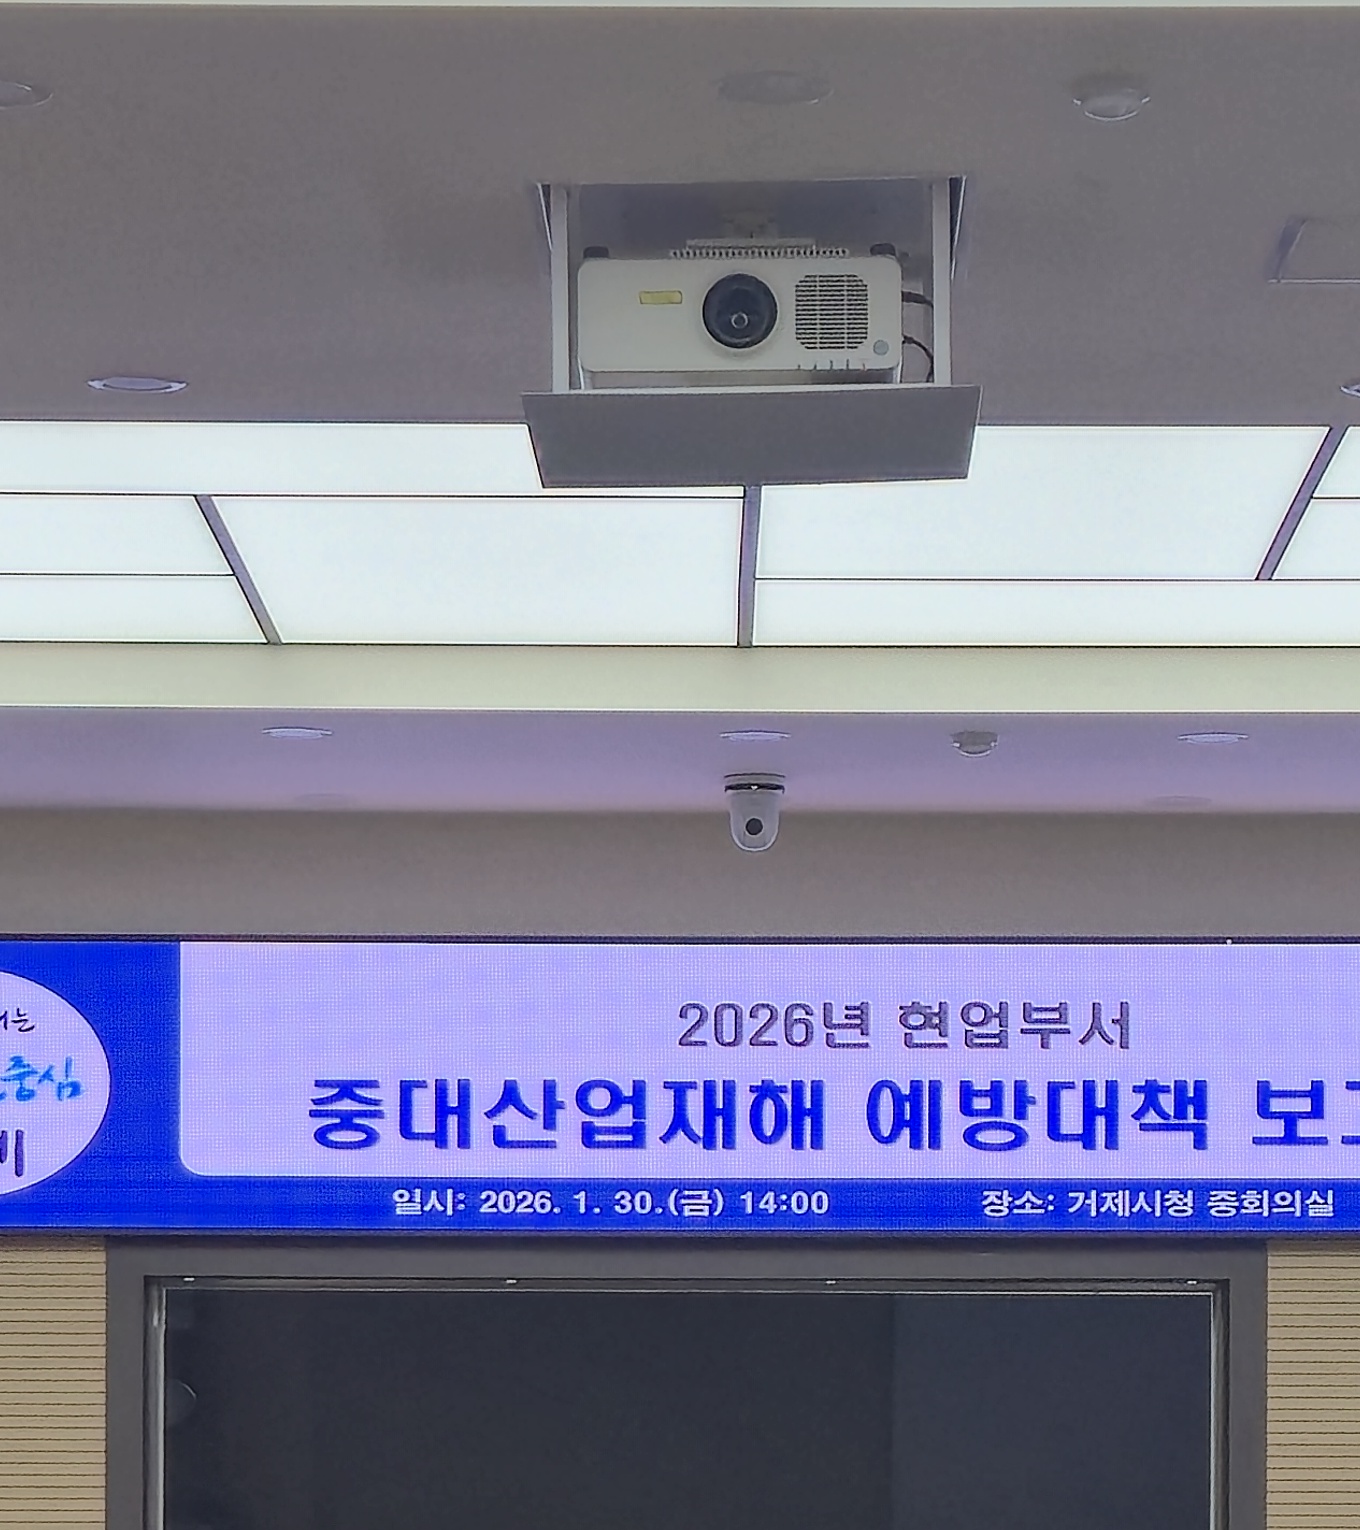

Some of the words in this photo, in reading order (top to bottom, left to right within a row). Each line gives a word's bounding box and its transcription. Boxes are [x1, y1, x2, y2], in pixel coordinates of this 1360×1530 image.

[678, 1002, 871, 1051] 2026년
[898, 1002, 1131, 1051] 현업부서
[308, 1079, 826, 1153] 중대산업재해
[866, 1079, 1210, 1153] 예방대책
[392, 1189, 467, 1217] 일시:
[479, 1190, 562, 1215] 2026.
[574, 1190, 602, 1215] 1.
[613, 1189, 725, 1217] 30.(금)
[740, 1191, 830, 1215] 14:00
[982, 1190, 1056, 1218] 장소:
[1068, 1190, 1195, 1218] 거제시청
[1207, 1190, 1335, 1218] 중회의실
